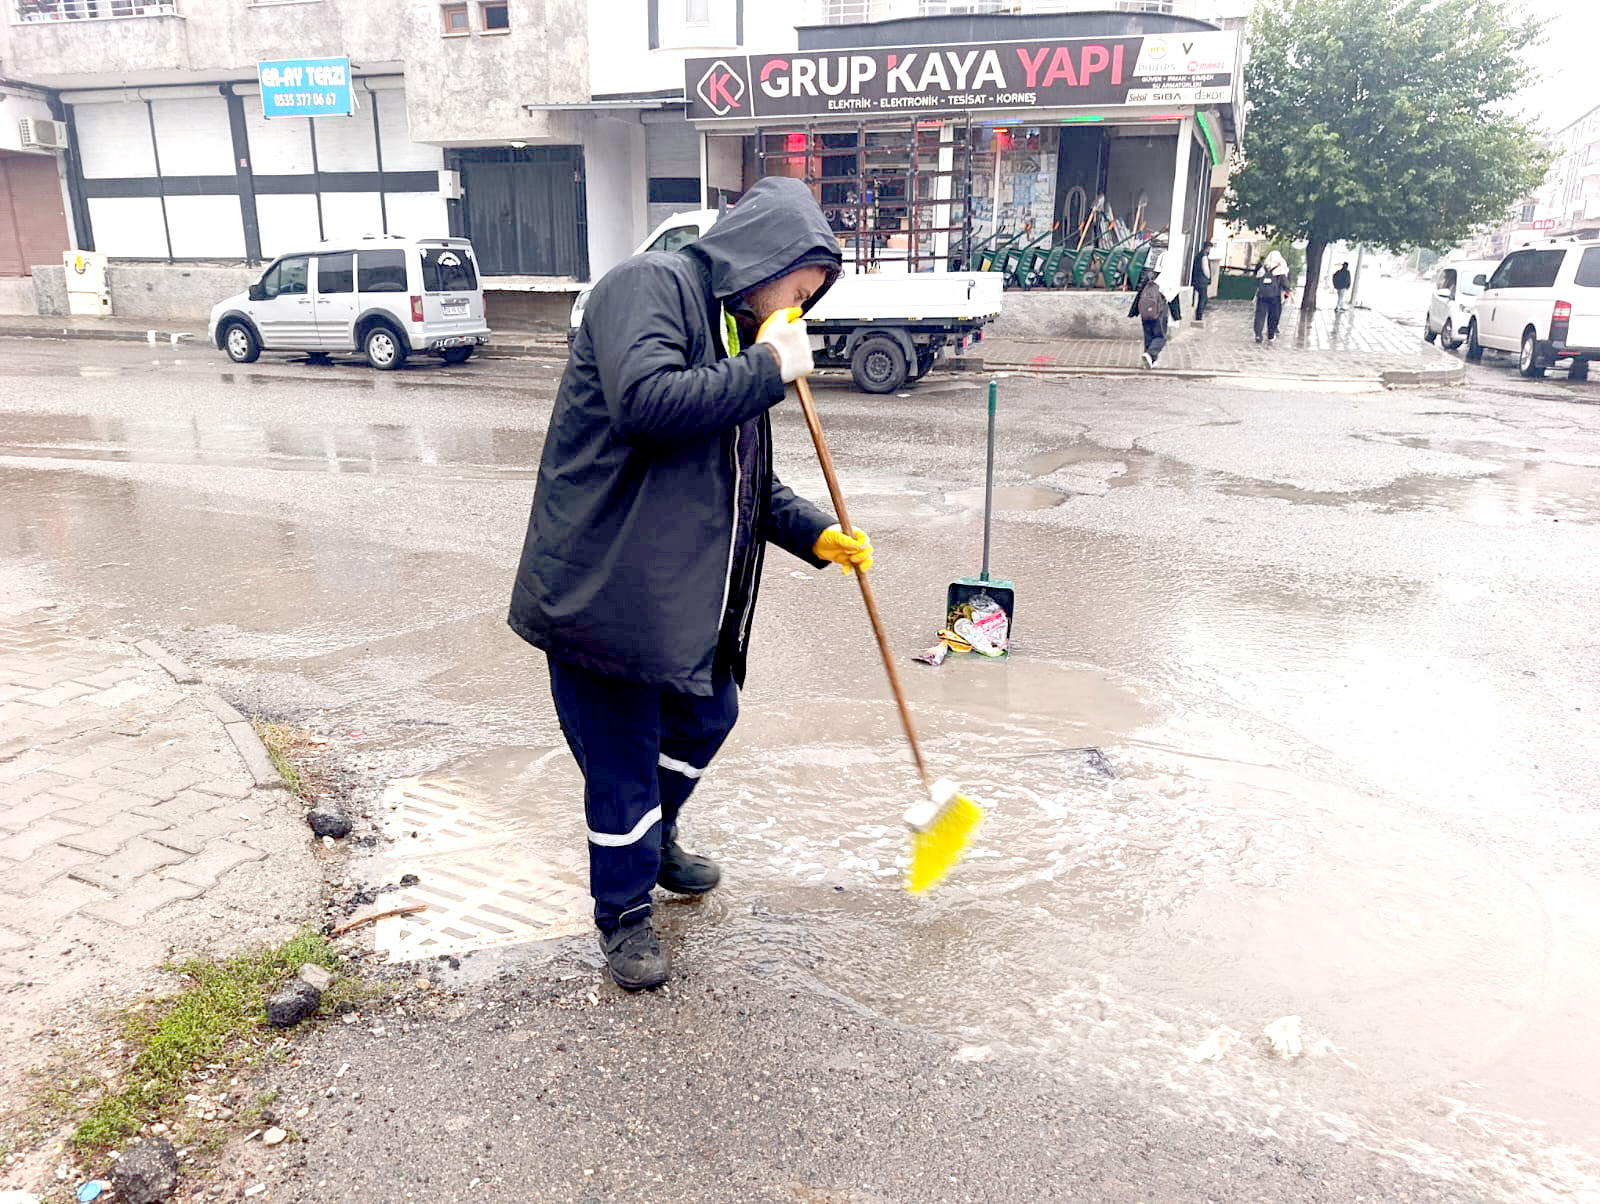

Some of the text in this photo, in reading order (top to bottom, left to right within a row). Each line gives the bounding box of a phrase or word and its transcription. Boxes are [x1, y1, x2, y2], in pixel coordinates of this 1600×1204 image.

[760, 43, 1125, 98] GRUP KAYA YAPI
[1138, 63, 1176, 72] PHILIPS
[709, 72, 740, 107] K
[274, 92, 337, 107] 0535 377 06 67
[828, 97, 871, 109] ELEKTRİK
[880, 94, 938, 108] ELEKTRONİK
[948, 92, 988, 105] TESİSAT
[996, 91, 1037, 105] KORNEŞ
